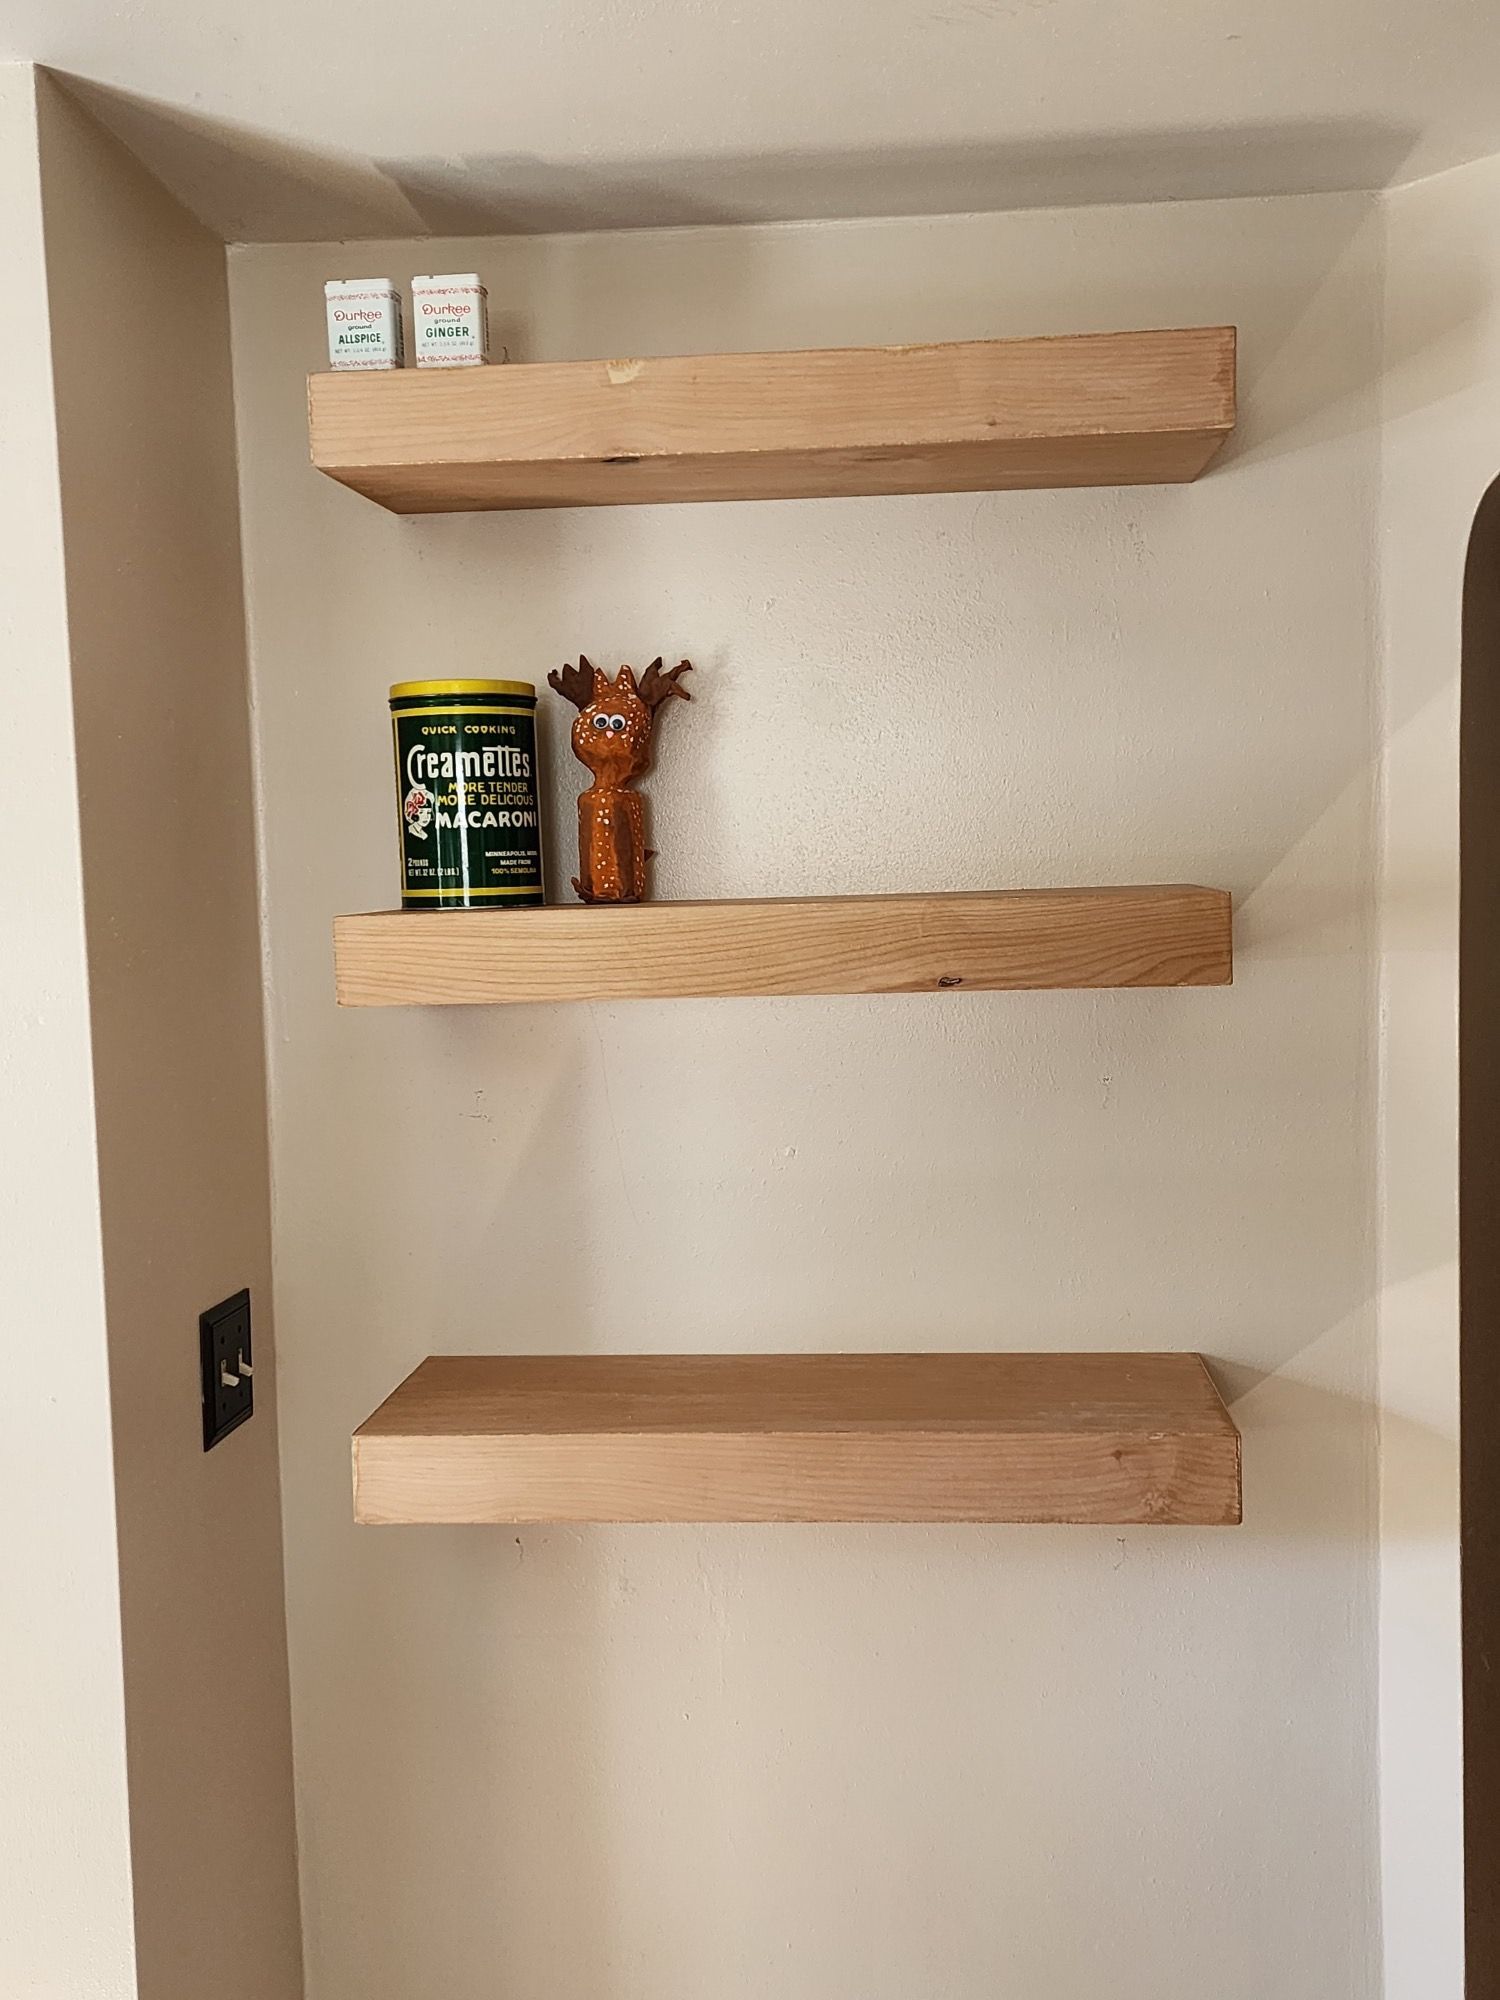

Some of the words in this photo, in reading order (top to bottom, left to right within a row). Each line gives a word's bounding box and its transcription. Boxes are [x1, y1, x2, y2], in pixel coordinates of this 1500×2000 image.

[334, 309, 382, 322] Durkee
[422, 303, 471, 317] Durkee
[338, 332, 382, 345] ALLSPICE
[425, 326, 470, 338] GINGER
[421, 725, 457, 735] QUICK
[464, 725, 516, 735] COOKING
[407, 744, 530, 789] Creamettes
[488, 782, 529, 792] TENDER
[437, 794, 477, 806] MOE
[480, 794, 534, 805] DELICIOUS
[435, 811, 537, 829] MACARONI
